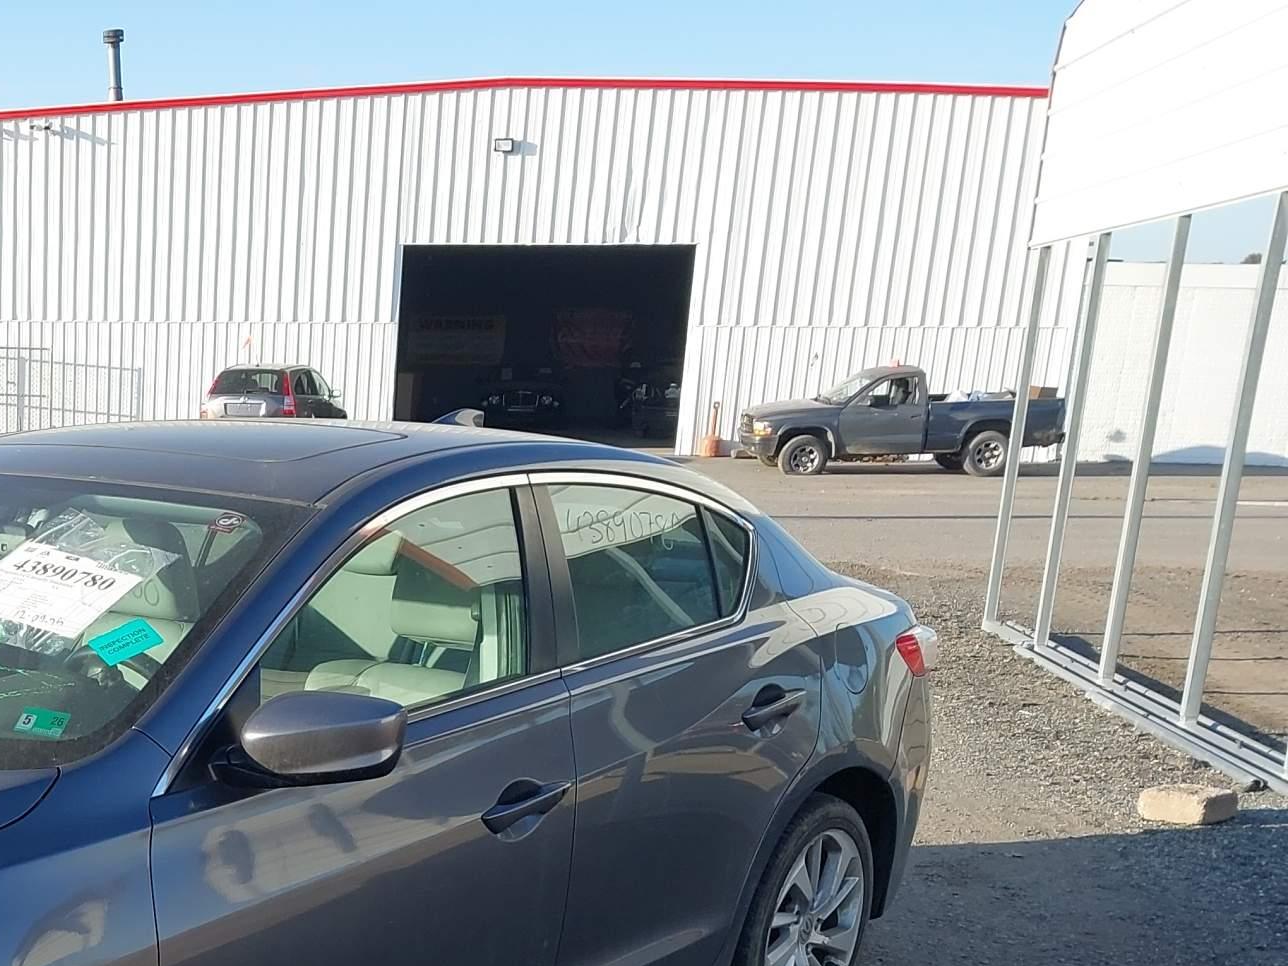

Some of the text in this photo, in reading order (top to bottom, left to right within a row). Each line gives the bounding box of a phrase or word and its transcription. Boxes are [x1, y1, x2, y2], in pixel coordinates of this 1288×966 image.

[13, 558, 117, 591] 43890780
[99, 626, 147, 652] INSPECTION
[107, 632, 151, 656] COMPLETE
[22, 714, 66, 727] 5 26
